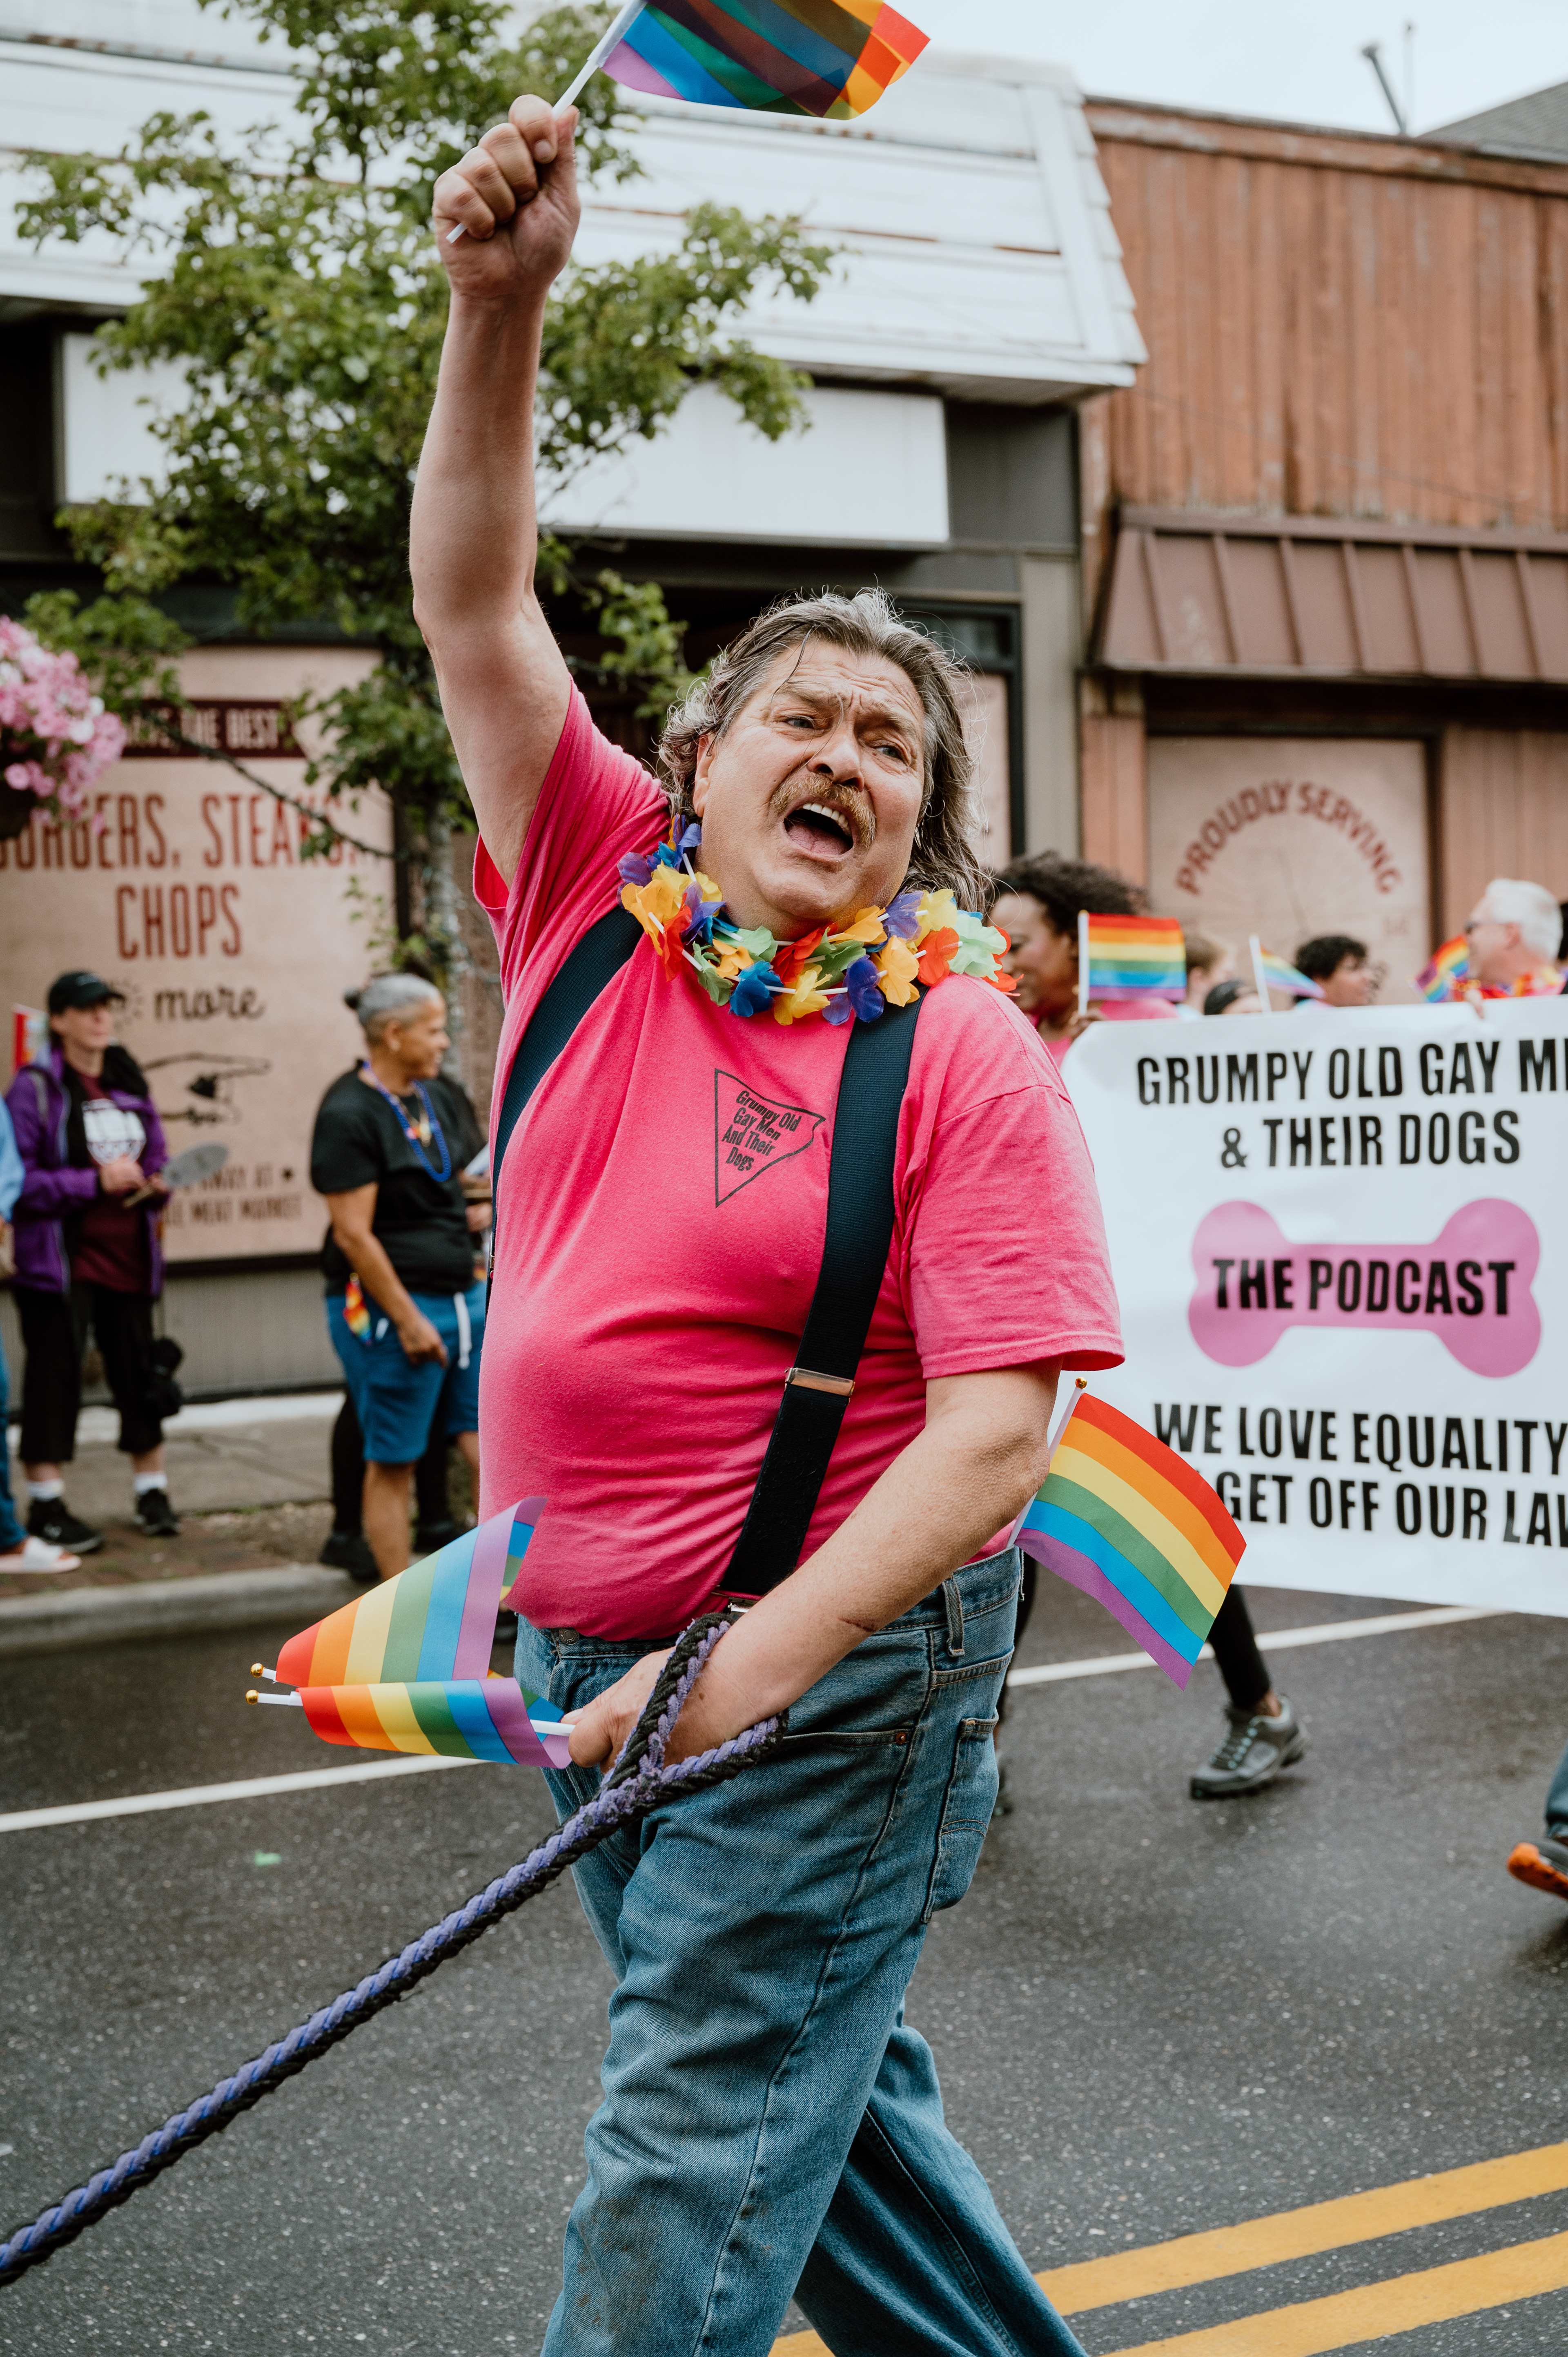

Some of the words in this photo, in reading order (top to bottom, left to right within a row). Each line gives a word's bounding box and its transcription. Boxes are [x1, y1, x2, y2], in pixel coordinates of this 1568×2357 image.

[225, 707, 279, 750] BEST
[1175, 778, 1293, 896] PROUDLY
[1297, 780, 1403, 896] SERVING
[115, 883, 242, 958] CHOPS
[152, 984, 266, 1022] more
[1137, 1051, 1313, 1105] GRUMPY
[1328, 1047, 1403, 1099] OLD
[1419, 1041, 1500, 1096] GAY
[722, 1124, 746, 1145] And
[744, 1131, 776, 1156] Their
[733, 1107, 757, 1133] Gay
[755, 1118, 781, 1141] Men
[735, 1090, 781, 1124] Grumpy
[778, 1112, 802, 1132] Old
[1221, 1128, 1247, 1168] &
[1263, 1116, 1382, 1167] THEIR
[1400, 1110, 1519, 1164] DOGS
[725, 1146, 755, 1171] Dogs
[1213, 1258, 1293, 1309] THE
[1309, 1259, 1515, 1316] PODCAST
[1154, 1403, 1222, 1454] WE
[1239, 1407, 1338, 1461] LOVE
[1353, 1413, 1568, 1475] EQUALITY
[1216, 1471, 1293, 1524] GET
[1310, 1477, 1379, 1532] OFF
[1396, 1483, 1487, 1540] OUR
